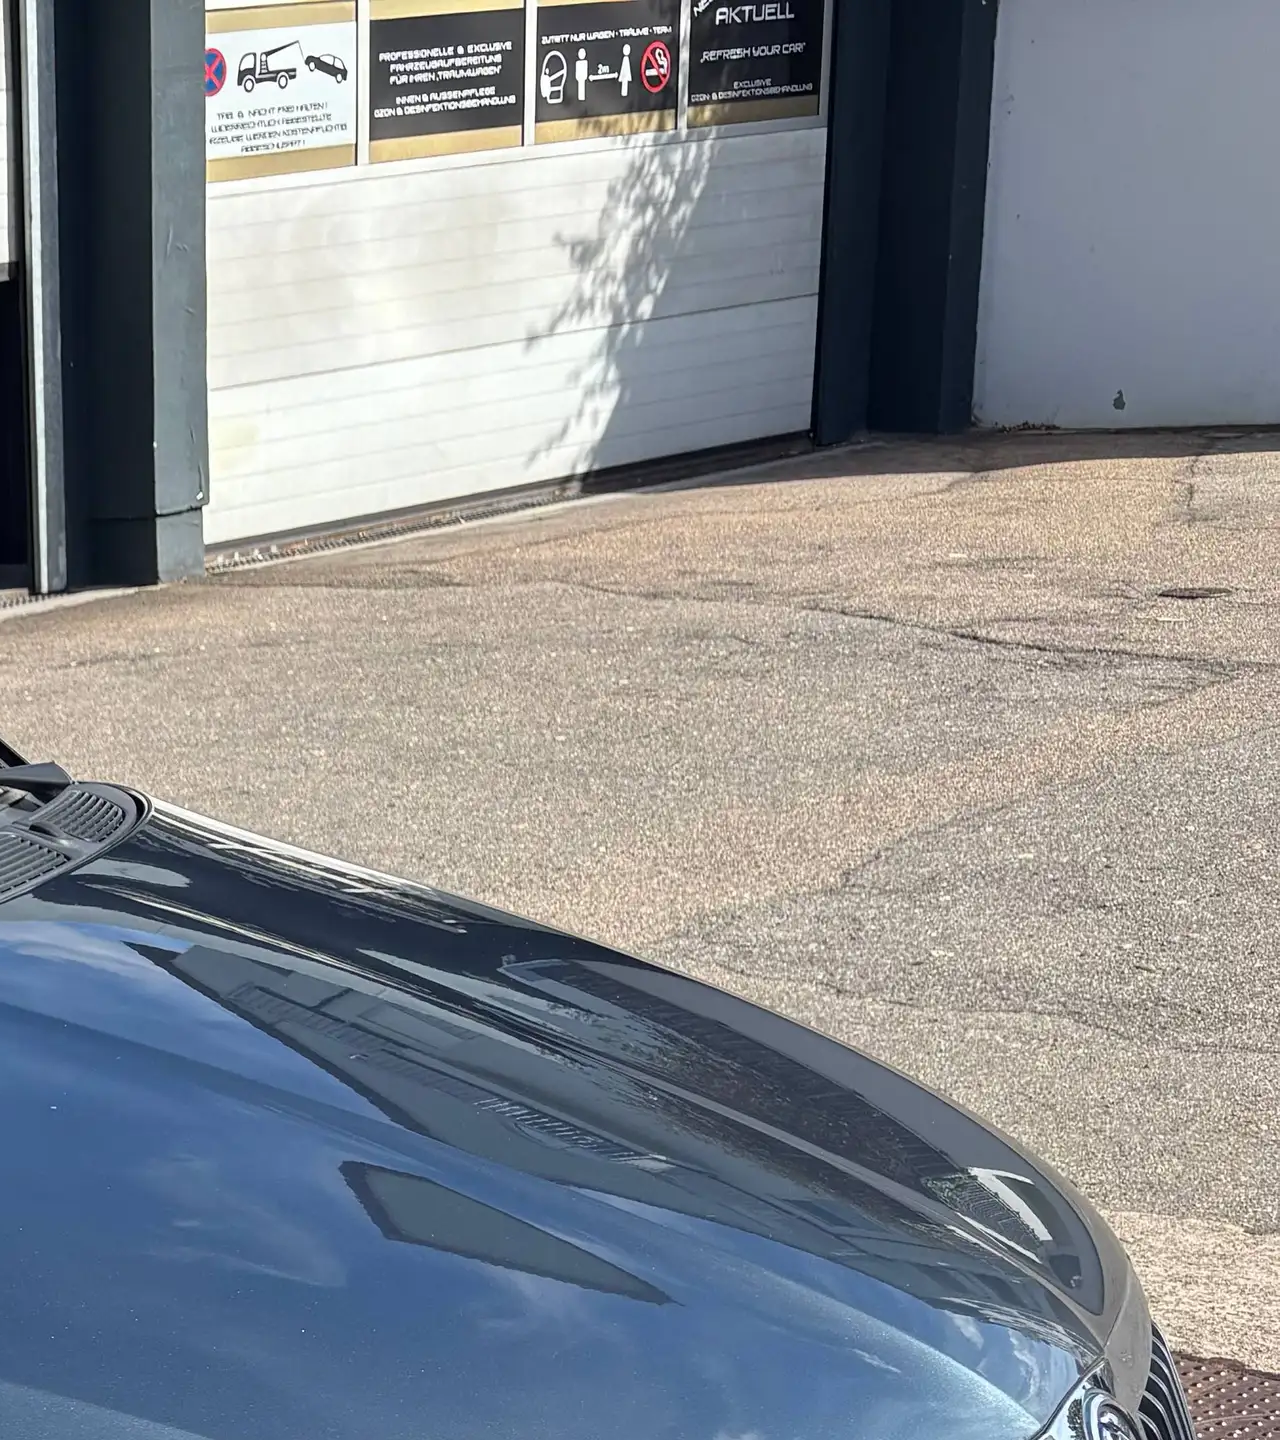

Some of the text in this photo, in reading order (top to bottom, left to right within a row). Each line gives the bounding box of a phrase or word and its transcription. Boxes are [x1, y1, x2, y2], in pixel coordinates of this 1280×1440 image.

[715, 1, 795, 25] AKTUELL
[467, 41, 512, 53] EXCLUSIVE
[752, 44, 781, 57] YOUR
